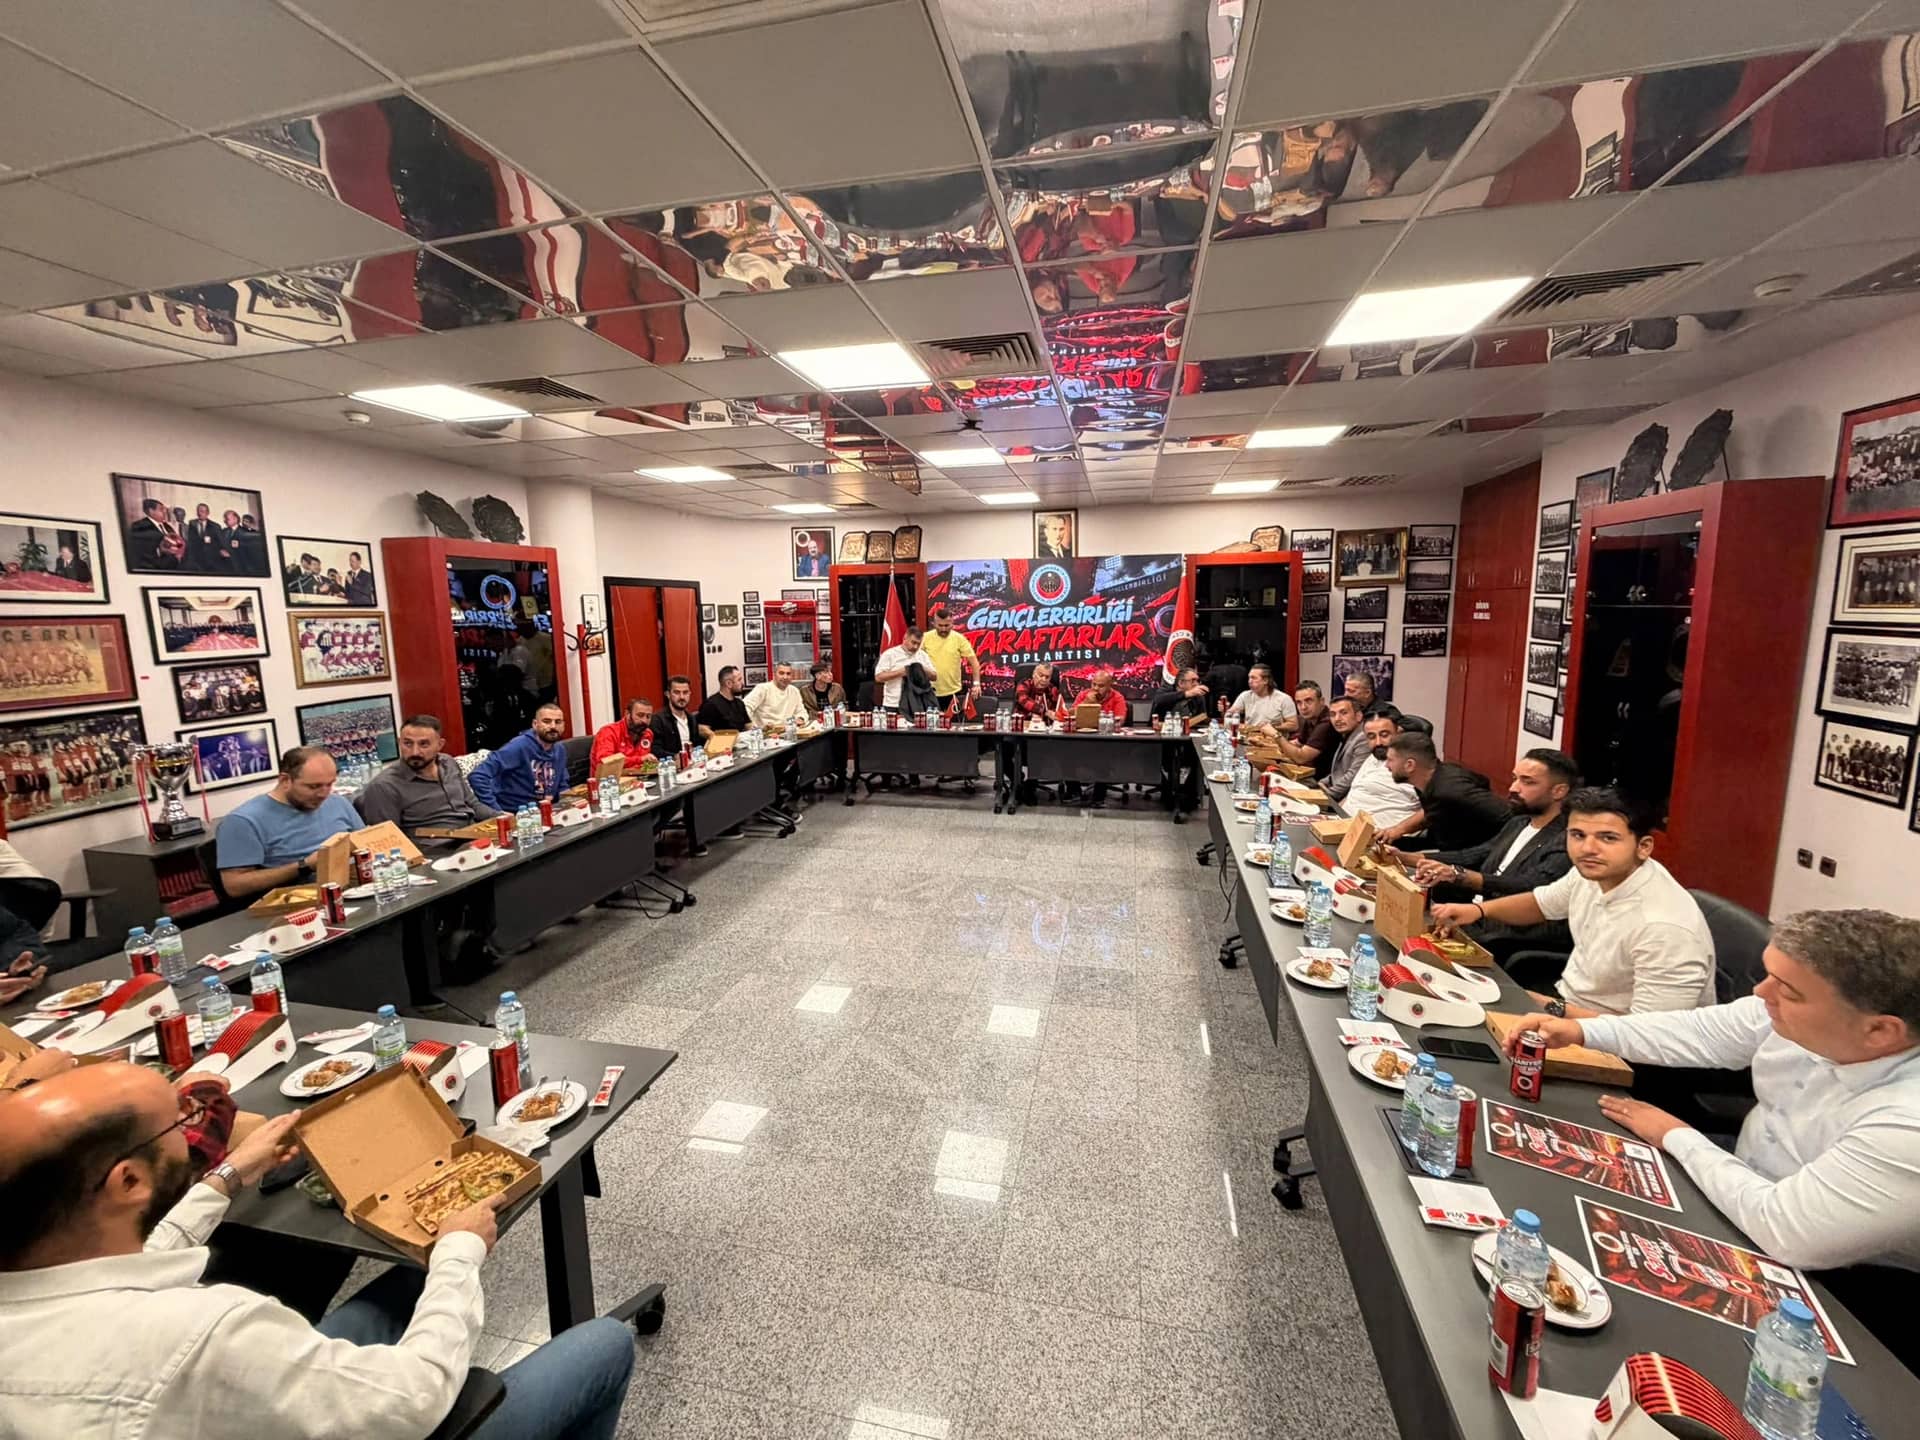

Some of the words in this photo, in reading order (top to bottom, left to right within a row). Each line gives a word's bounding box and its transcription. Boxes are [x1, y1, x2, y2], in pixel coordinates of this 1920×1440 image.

[967, 598, 1134, 630] GENÇLERBİRLİĞİ
[965, 624, 1148, 656] TARAFTARLAR
[1001, 649, 1101, 665] TOPLANTISI
